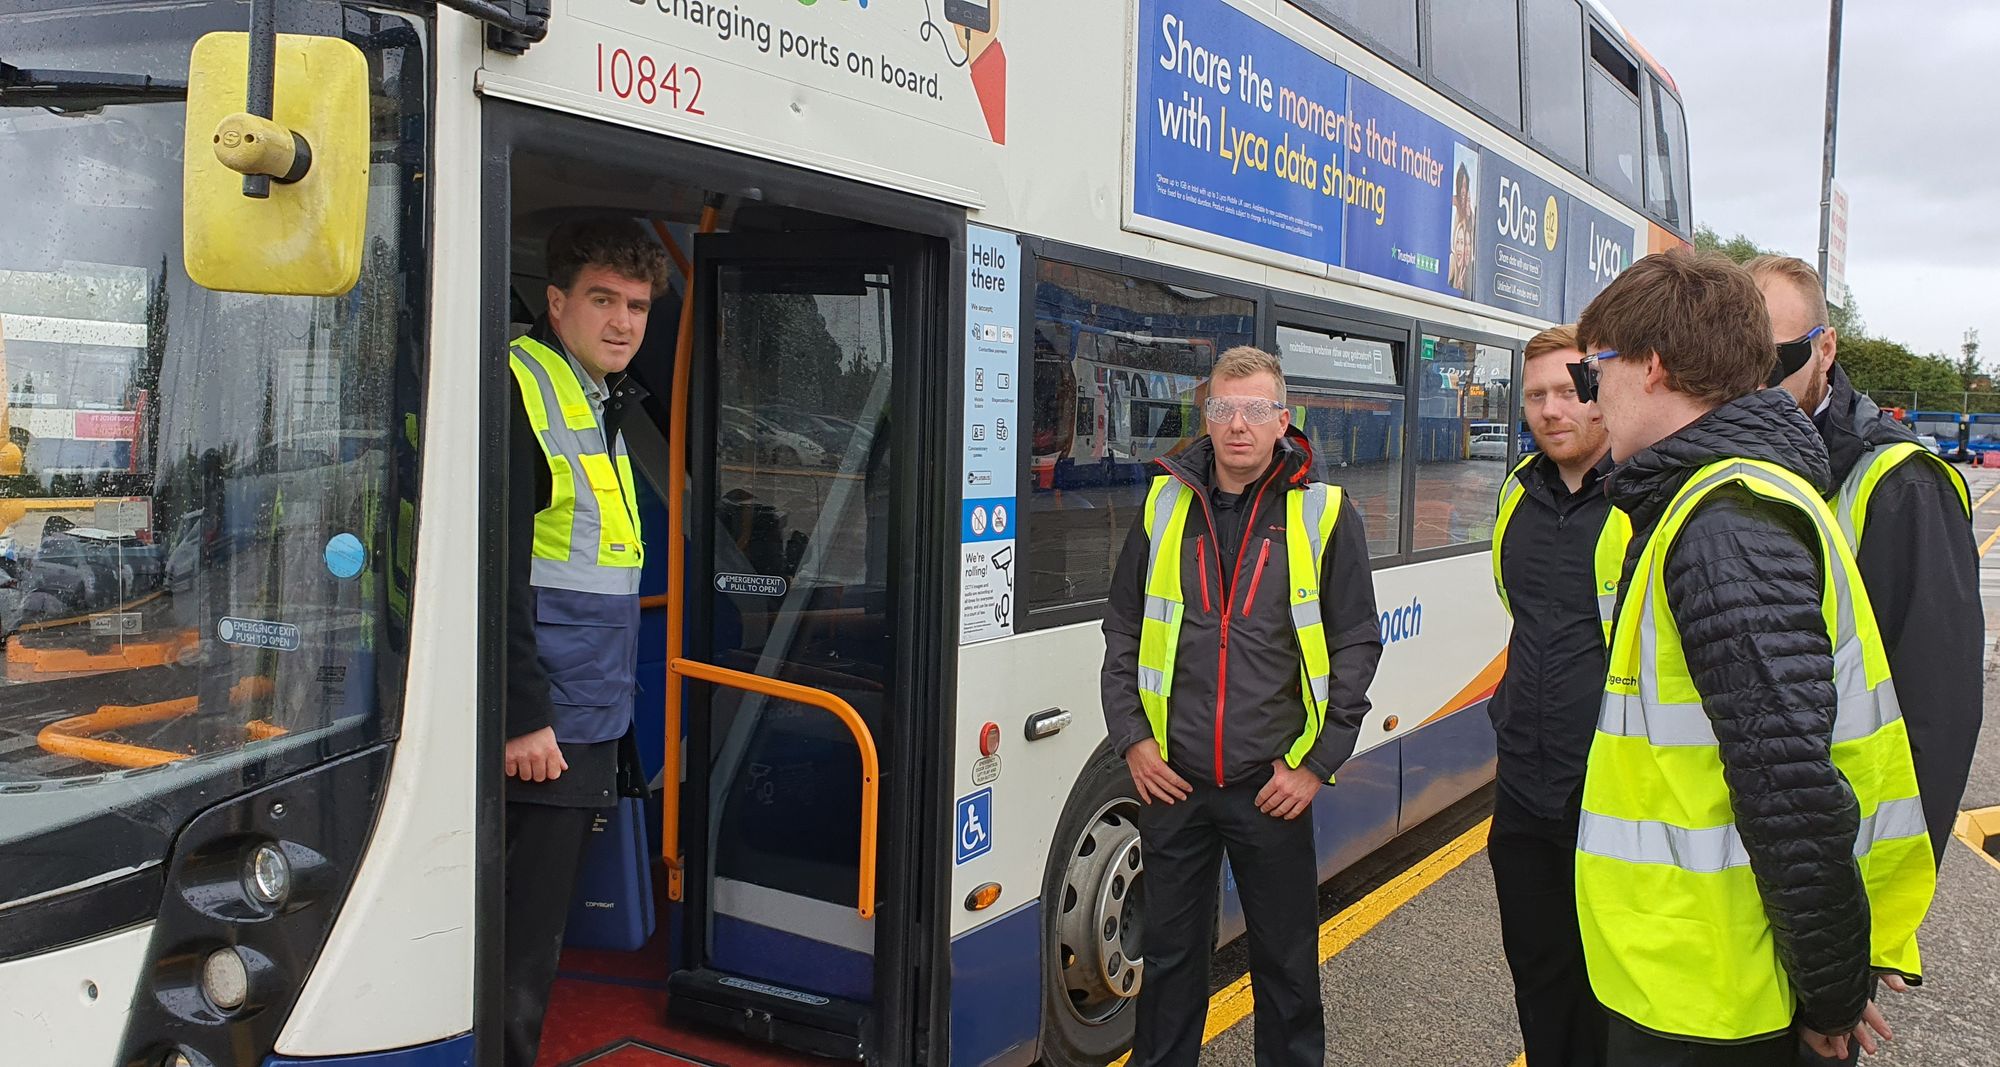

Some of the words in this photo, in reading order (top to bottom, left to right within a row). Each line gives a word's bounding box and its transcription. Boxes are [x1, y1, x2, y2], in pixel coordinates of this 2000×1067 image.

[657, 0, 771, 53] charging
[779, 28, 840, 68] ports
[847, 52, 873, 79] on
[881, 54, 943, 101] board.
[597, 43, 705, 116] 10842
[1160, 13, 1232, 95] Share
[1239, 54, 1273, 113] the
[1279, 86, 1361, 154] moments
[1366, 118, 1398, 168] that
[1401, 144, 1444, 188] matter
[1158, 91, 1211, 152] with
[1219, 106, 1269, 175] Lyca
[1275, 132, 1317, 190] data
[1322, 154, 1386, 226] sharing
[972, 243, 1005, 270] Hello
[1589, 221, 1621, 283] Lyca
[971, 267, 1006, 293] there
[965, 564, 988, 578] rolling!
[966, 552, 985, 564] We're
[726, 575, 765, 585] EMERGENCY
[730, 583, 746, 591] PULL
[758, 585, 777, 593] OPEN
[233, 621, 277, 635] EMERGENCY
[278, 627, 295, 637] EXIT
[1380, 595, 1422, 646] oach
[236, 632, 256, 643] PUSH
[257, 634, 267, 644] TO
[269, 637, 290, 647] OPEN
